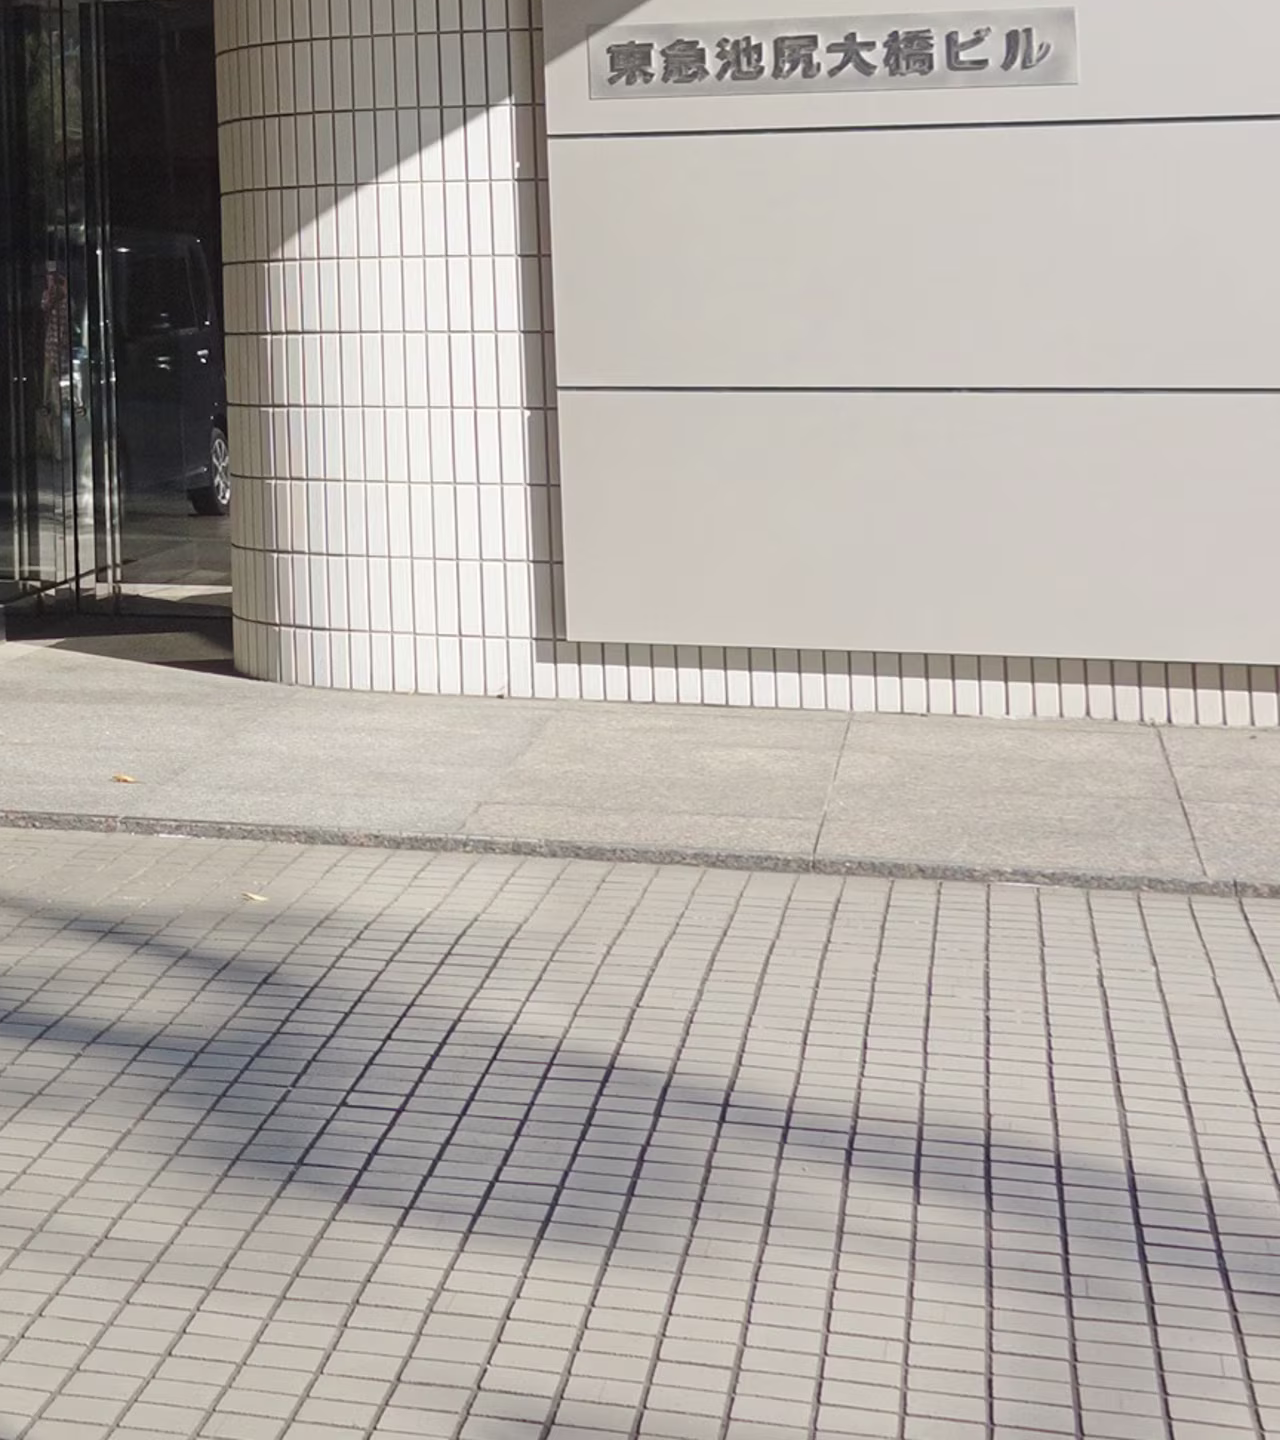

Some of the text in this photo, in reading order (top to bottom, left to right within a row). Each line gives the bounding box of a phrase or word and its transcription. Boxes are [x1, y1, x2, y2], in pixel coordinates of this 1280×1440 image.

[606, 26, 1051, 85] 東急池尻大橋ビル
